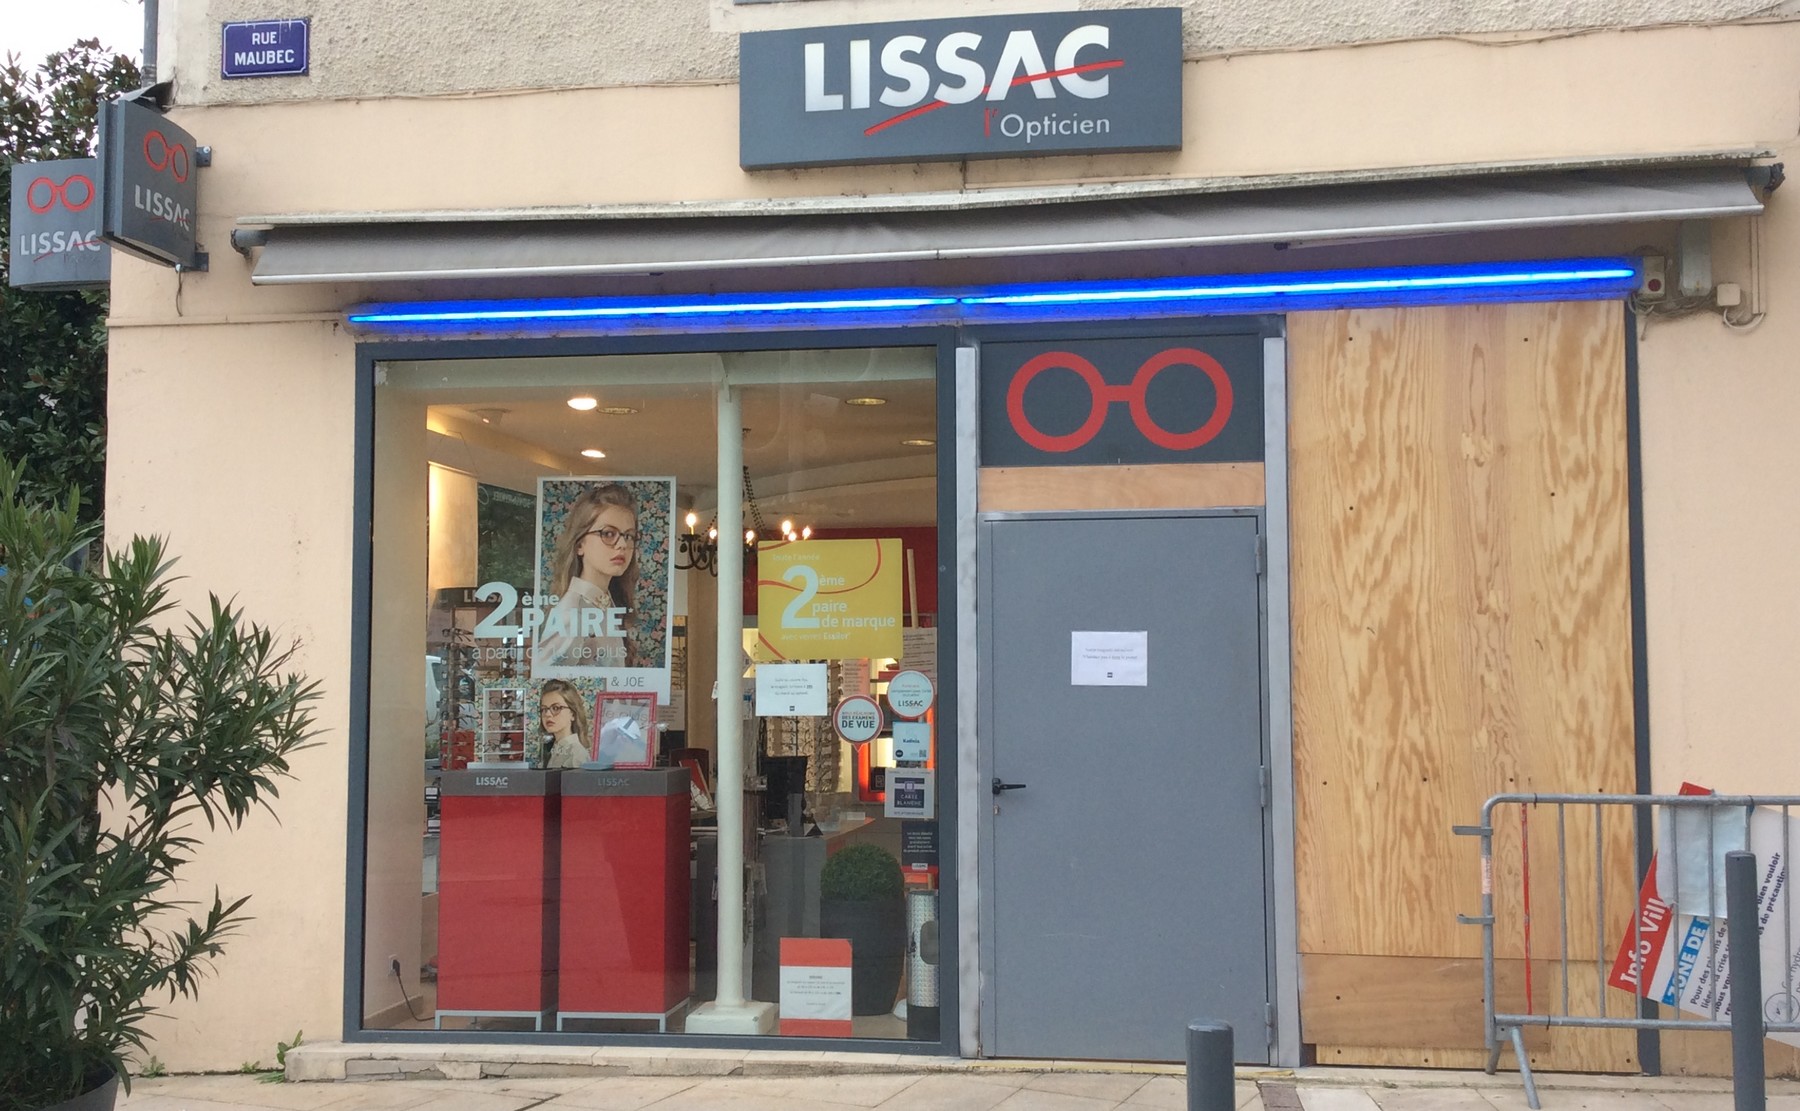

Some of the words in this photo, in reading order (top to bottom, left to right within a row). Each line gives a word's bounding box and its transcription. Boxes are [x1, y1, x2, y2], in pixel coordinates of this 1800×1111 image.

[251, 31, 278, 45] RUE
[234, 49, 295, 67] MAUBEC
[804, 24, 1110, 112] LISSAC
[133, 184, 191, 232] LISSAC
[20, 229, 101, 256] LISSAC
[812, 600, 848, 616] paire
[821, 614, 841, 628] de
[842, 616, 896, 631] marque
[486, 646, 527, 662] parti
[572, 644, 593, 659] de
[596, 643, 627, 662] plus
[623, 676, 645, 688] JOE
[897, 700, 924, 708] LISSAC
[841, 720, 854, 729] DE
[856, 720, 876, 729] VUE
[475, 776, 509, 786] LISSAC
[597, 777, 630, 787] LISSAC
[1764, 851, 1782, 885] vouloir
[1640, 897, 1667, 933] Vill
[1690, 925, 1709, 951] DE
[1717, 954, 1729, 973] crise
[1690, 984, 1704, 1006] Pour
[1699, 969, 1711, 985] des
